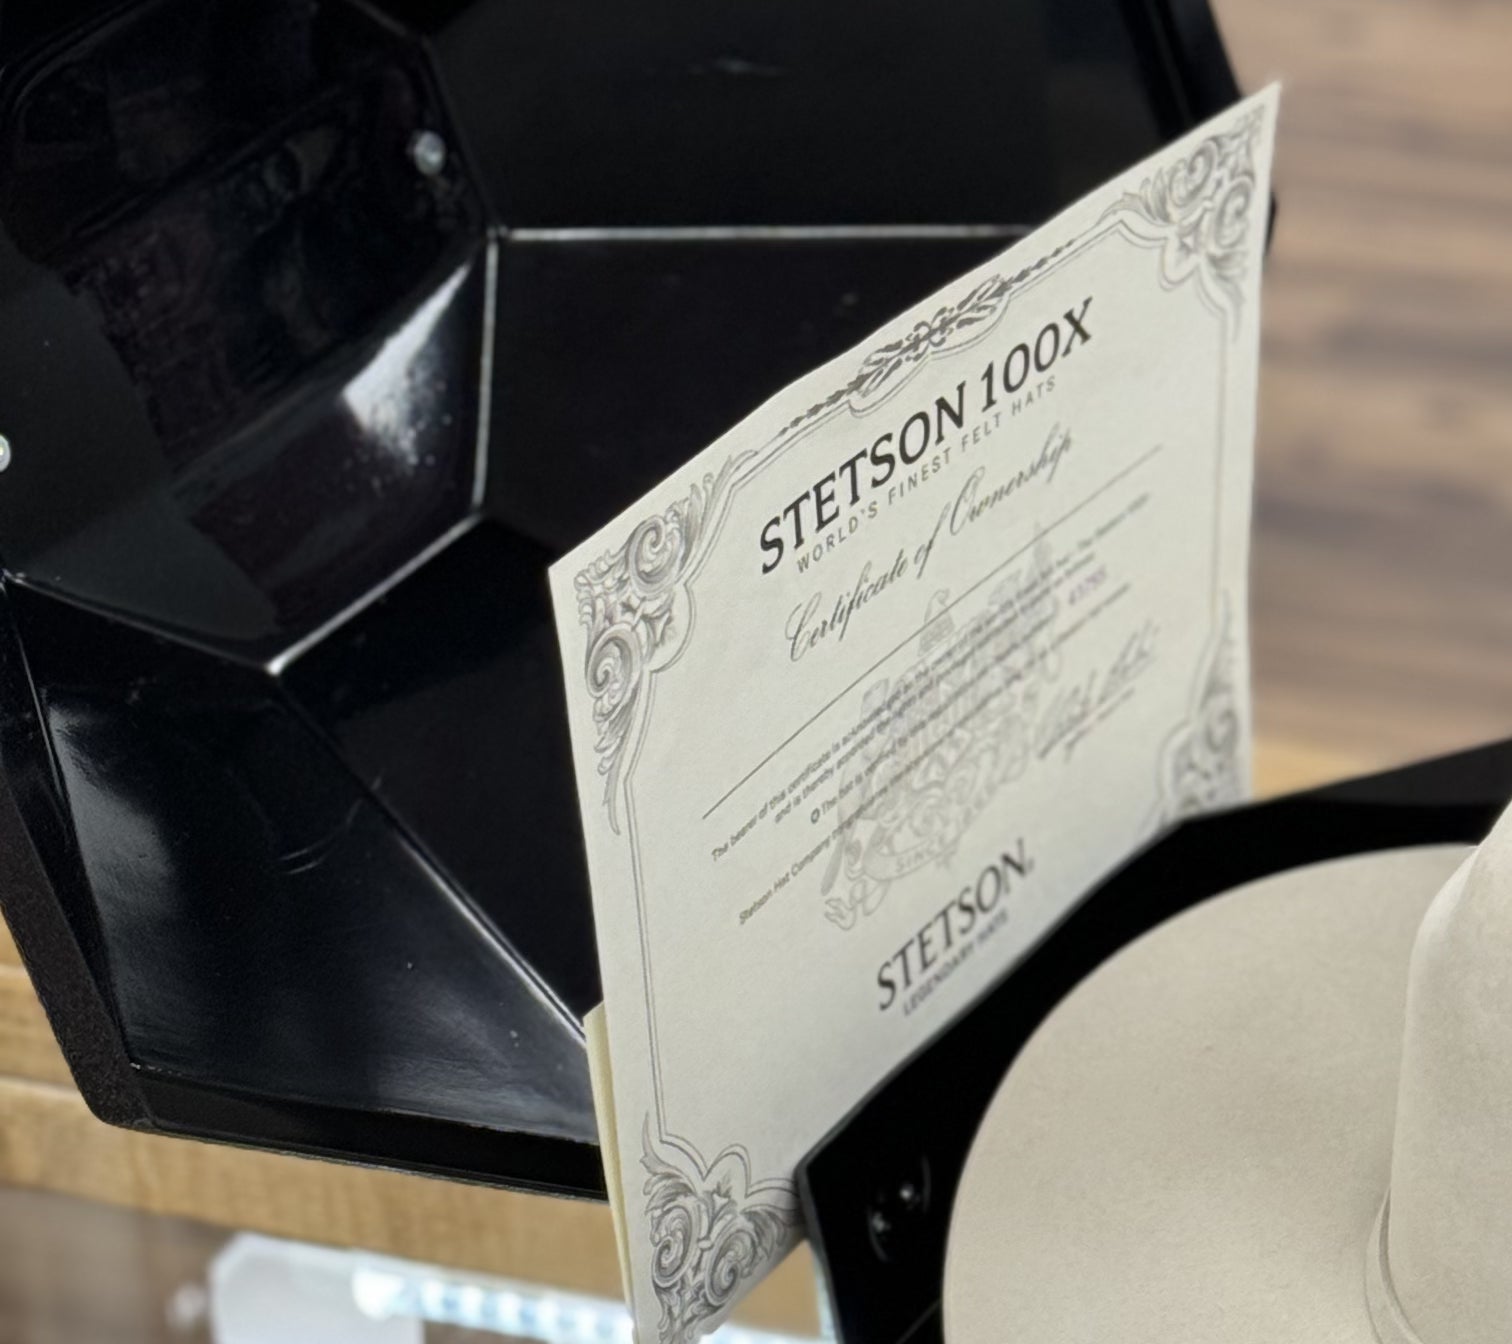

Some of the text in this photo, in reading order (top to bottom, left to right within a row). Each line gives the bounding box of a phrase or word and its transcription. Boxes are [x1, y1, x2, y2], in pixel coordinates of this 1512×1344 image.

[760, 381, 966, 575] STETSON
[981, 296, 1094, 412] 100X
[797, 375, 1056, 574] WORLD'S FINEST FELT HATS
[785, 549, 911, 662] Certificate
[903, 503, 951, 580] of
[949, 422, 1073, 540] Ownership
[711, 836, 728, 864] The
[730, 813, 757, 848] bearer
[758, 801, 767, 821] of
[769, 786, 785, 811] this
[787, 747, 831, 795] certificate
[831, 737, 840, 755] is
[775, 800, 791, 825] and
[793, 792, 801, 808] is
[821, 790, 837, 817] The
[739, 886, 772, 927] Stetson
[774, 869, 789, 894] Hat
[791, 833, 830, 878] Company
[877, 839, 1028, 1012] STETSON
